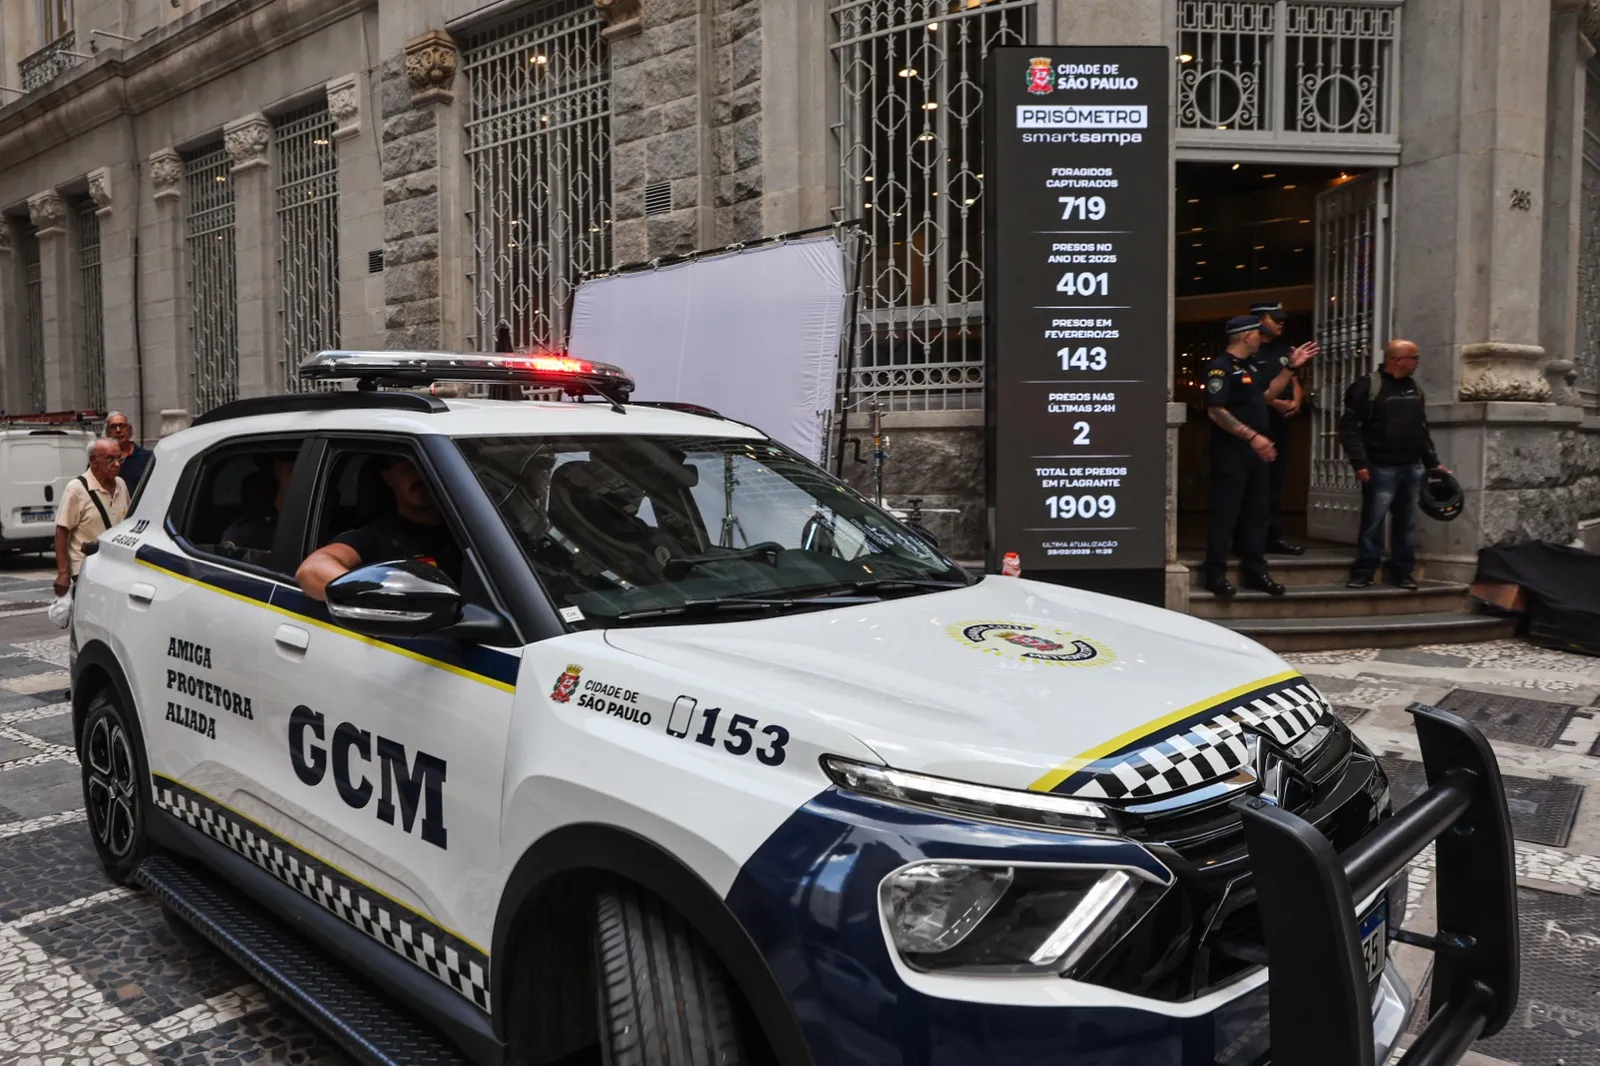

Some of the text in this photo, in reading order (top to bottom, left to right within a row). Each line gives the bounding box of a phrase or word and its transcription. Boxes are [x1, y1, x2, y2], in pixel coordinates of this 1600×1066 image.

[1058, 64, 1119, 74] CIDADE DE
[1058, 75, 1138, 89] SÃO PAULO
[1023, 108, 1141, 123] PRISÔMETRO
[1051, 167, 1113, 177] FORAGIDOS
[1045, 179, 1119, 188] CAPTURADOS
[1059, 196, 1105, 220] 719
[1052, 243, 1113, 252] PRESOS NO
[1047, 254, 1118, 264] ANO DE 2025
[1057, 272, 1107, 296] 401
[1051, 318, 1113, 328] PRESOS EM
[1044, 329, 1120, 339] FEVEREIRO/25
[1057, 347, 1107, 370] 143
[1048, 392, 1115, 402] PRESOS NAS
[1048, 403, 1116, 413] ÚLTIMAS 24H
[1073, 422, 1090, 444] 2
[1035, 466, 1128, 477] TOTAL DE PRESOS
[1041, 478, 1121, 488] EM FLAGRANTE
[1046, 495, 1116, 518] 1909
[168, 637, 211, 670] AMIGA
[166, 668, 253, 721] PROTETORA
[583, 680, 639, 703] CIDADE DE
[578, 693, 651, 725] SÃO PAULO
[165, 701, 217, 740] ALIADA
[694, 706, 789, 766] 153
[288, 704, 447, 851] GCM
